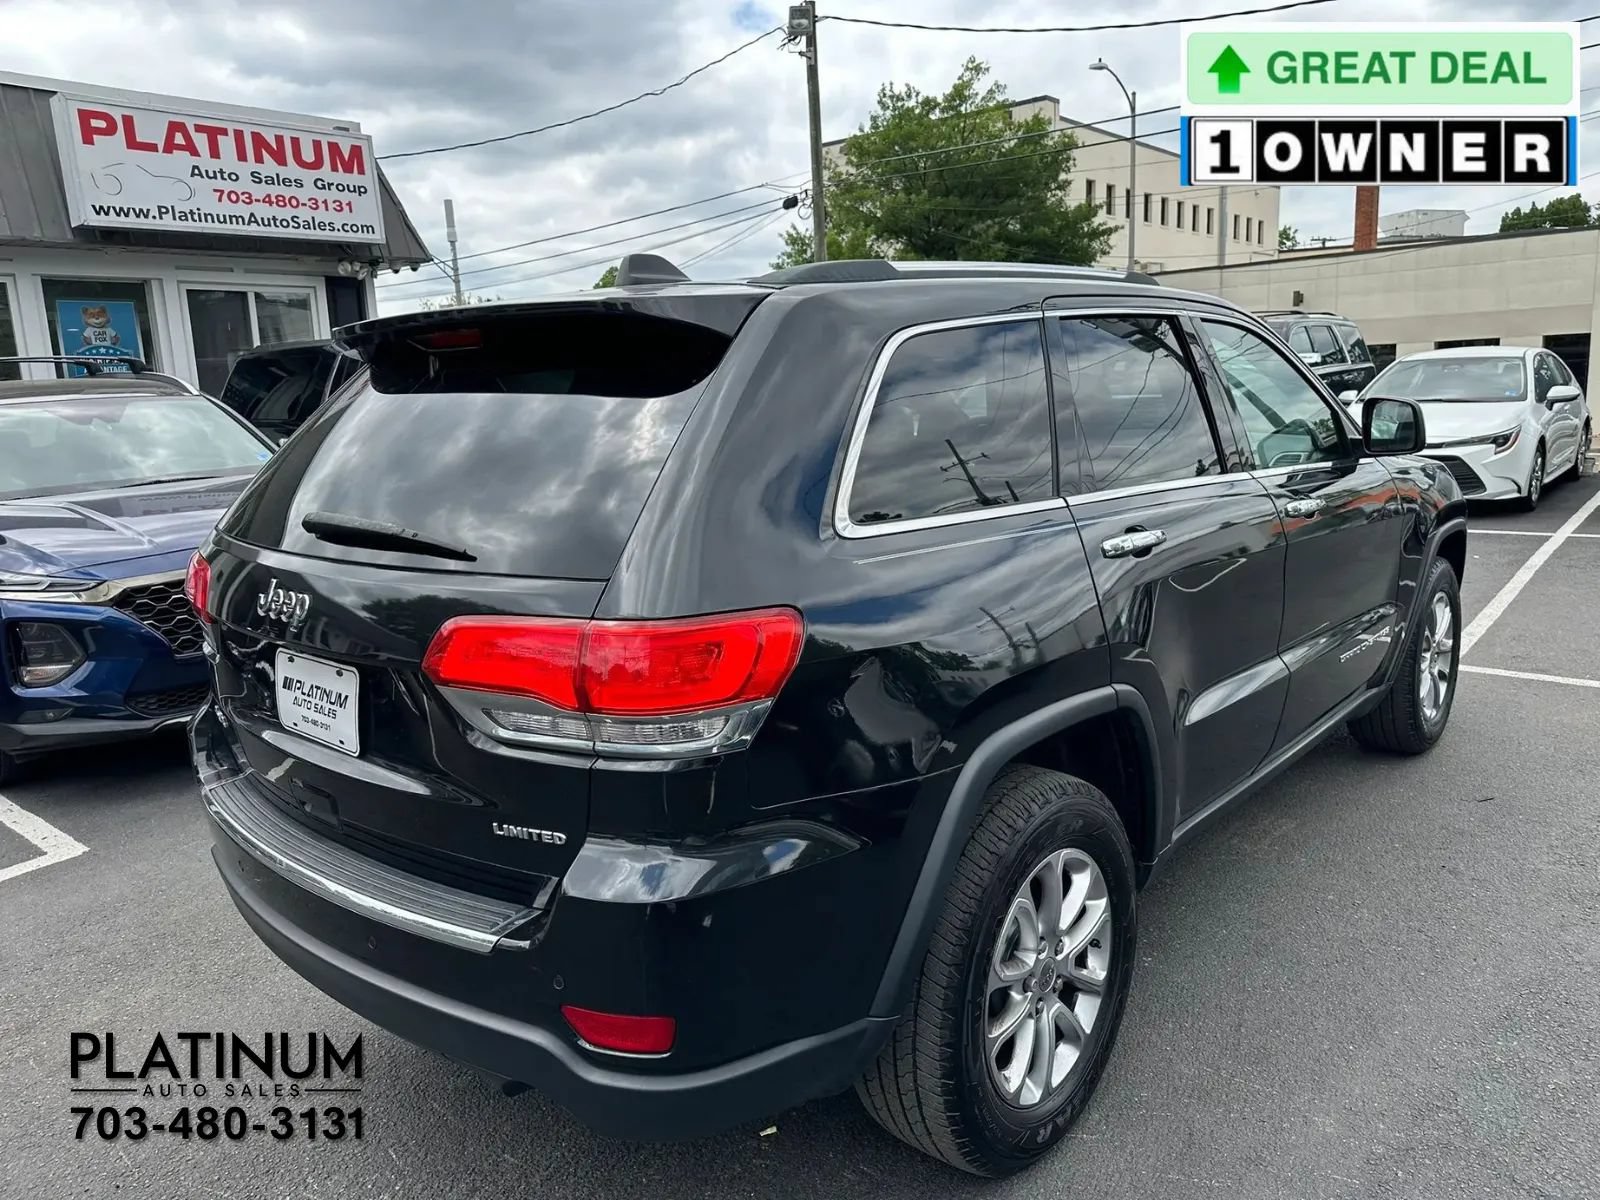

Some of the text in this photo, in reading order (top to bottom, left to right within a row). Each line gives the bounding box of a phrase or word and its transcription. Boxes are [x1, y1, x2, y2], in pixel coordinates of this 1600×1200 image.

[77, 108, 366, 175] PLATINUM
[190, 164, 368, 197] Auto Sales Group
[212, 188, 353, 213] 703-480-3131
[91, 203, 376, 235] www.PlatinumAutoSales.com
[257, 578, 310, 632] Jeep
[292, 696, 337, 719] AUTO SALES
[294, 679, 349, 709] PLATINUM
[492, 822, 566, 845] LIMITED
